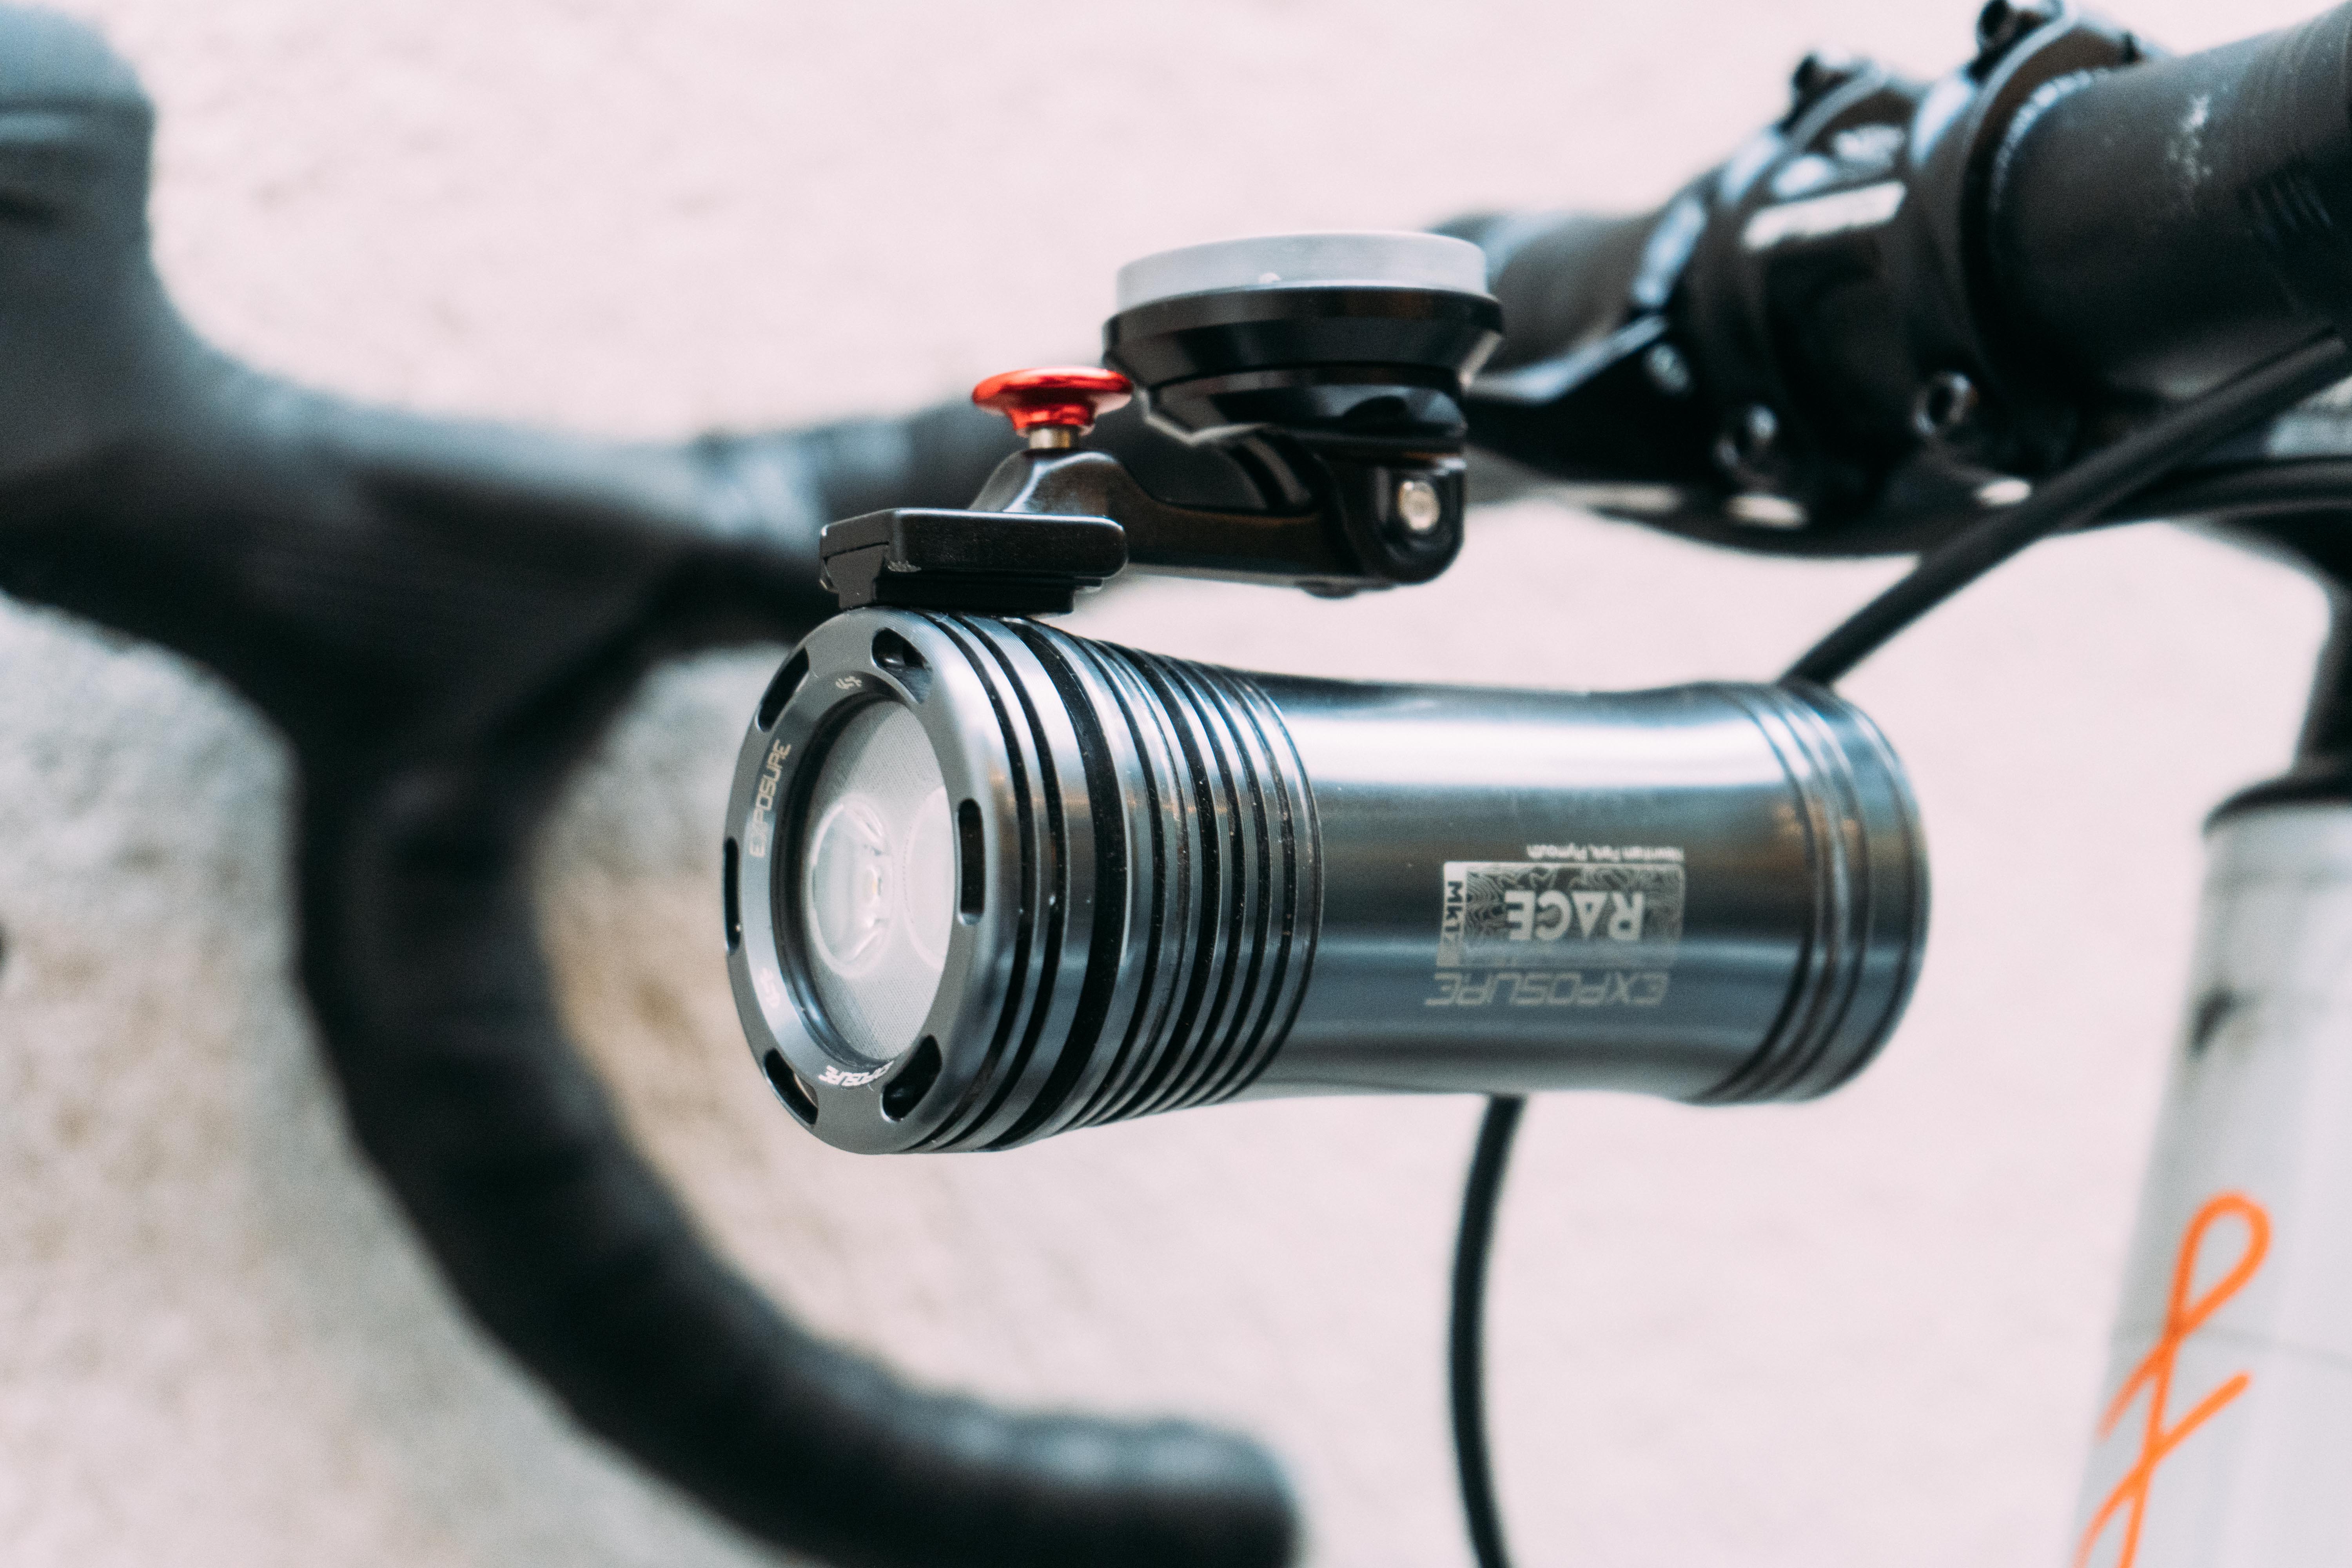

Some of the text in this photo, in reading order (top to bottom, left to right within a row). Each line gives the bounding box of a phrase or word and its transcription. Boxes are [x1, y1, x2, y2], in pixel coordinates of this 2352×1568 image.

[749, 739, 791, 858] EXPOSURE
[1504, 890, 1644, 941] RACE
[1425, 972, 1669, 1006] EXPOSURE
